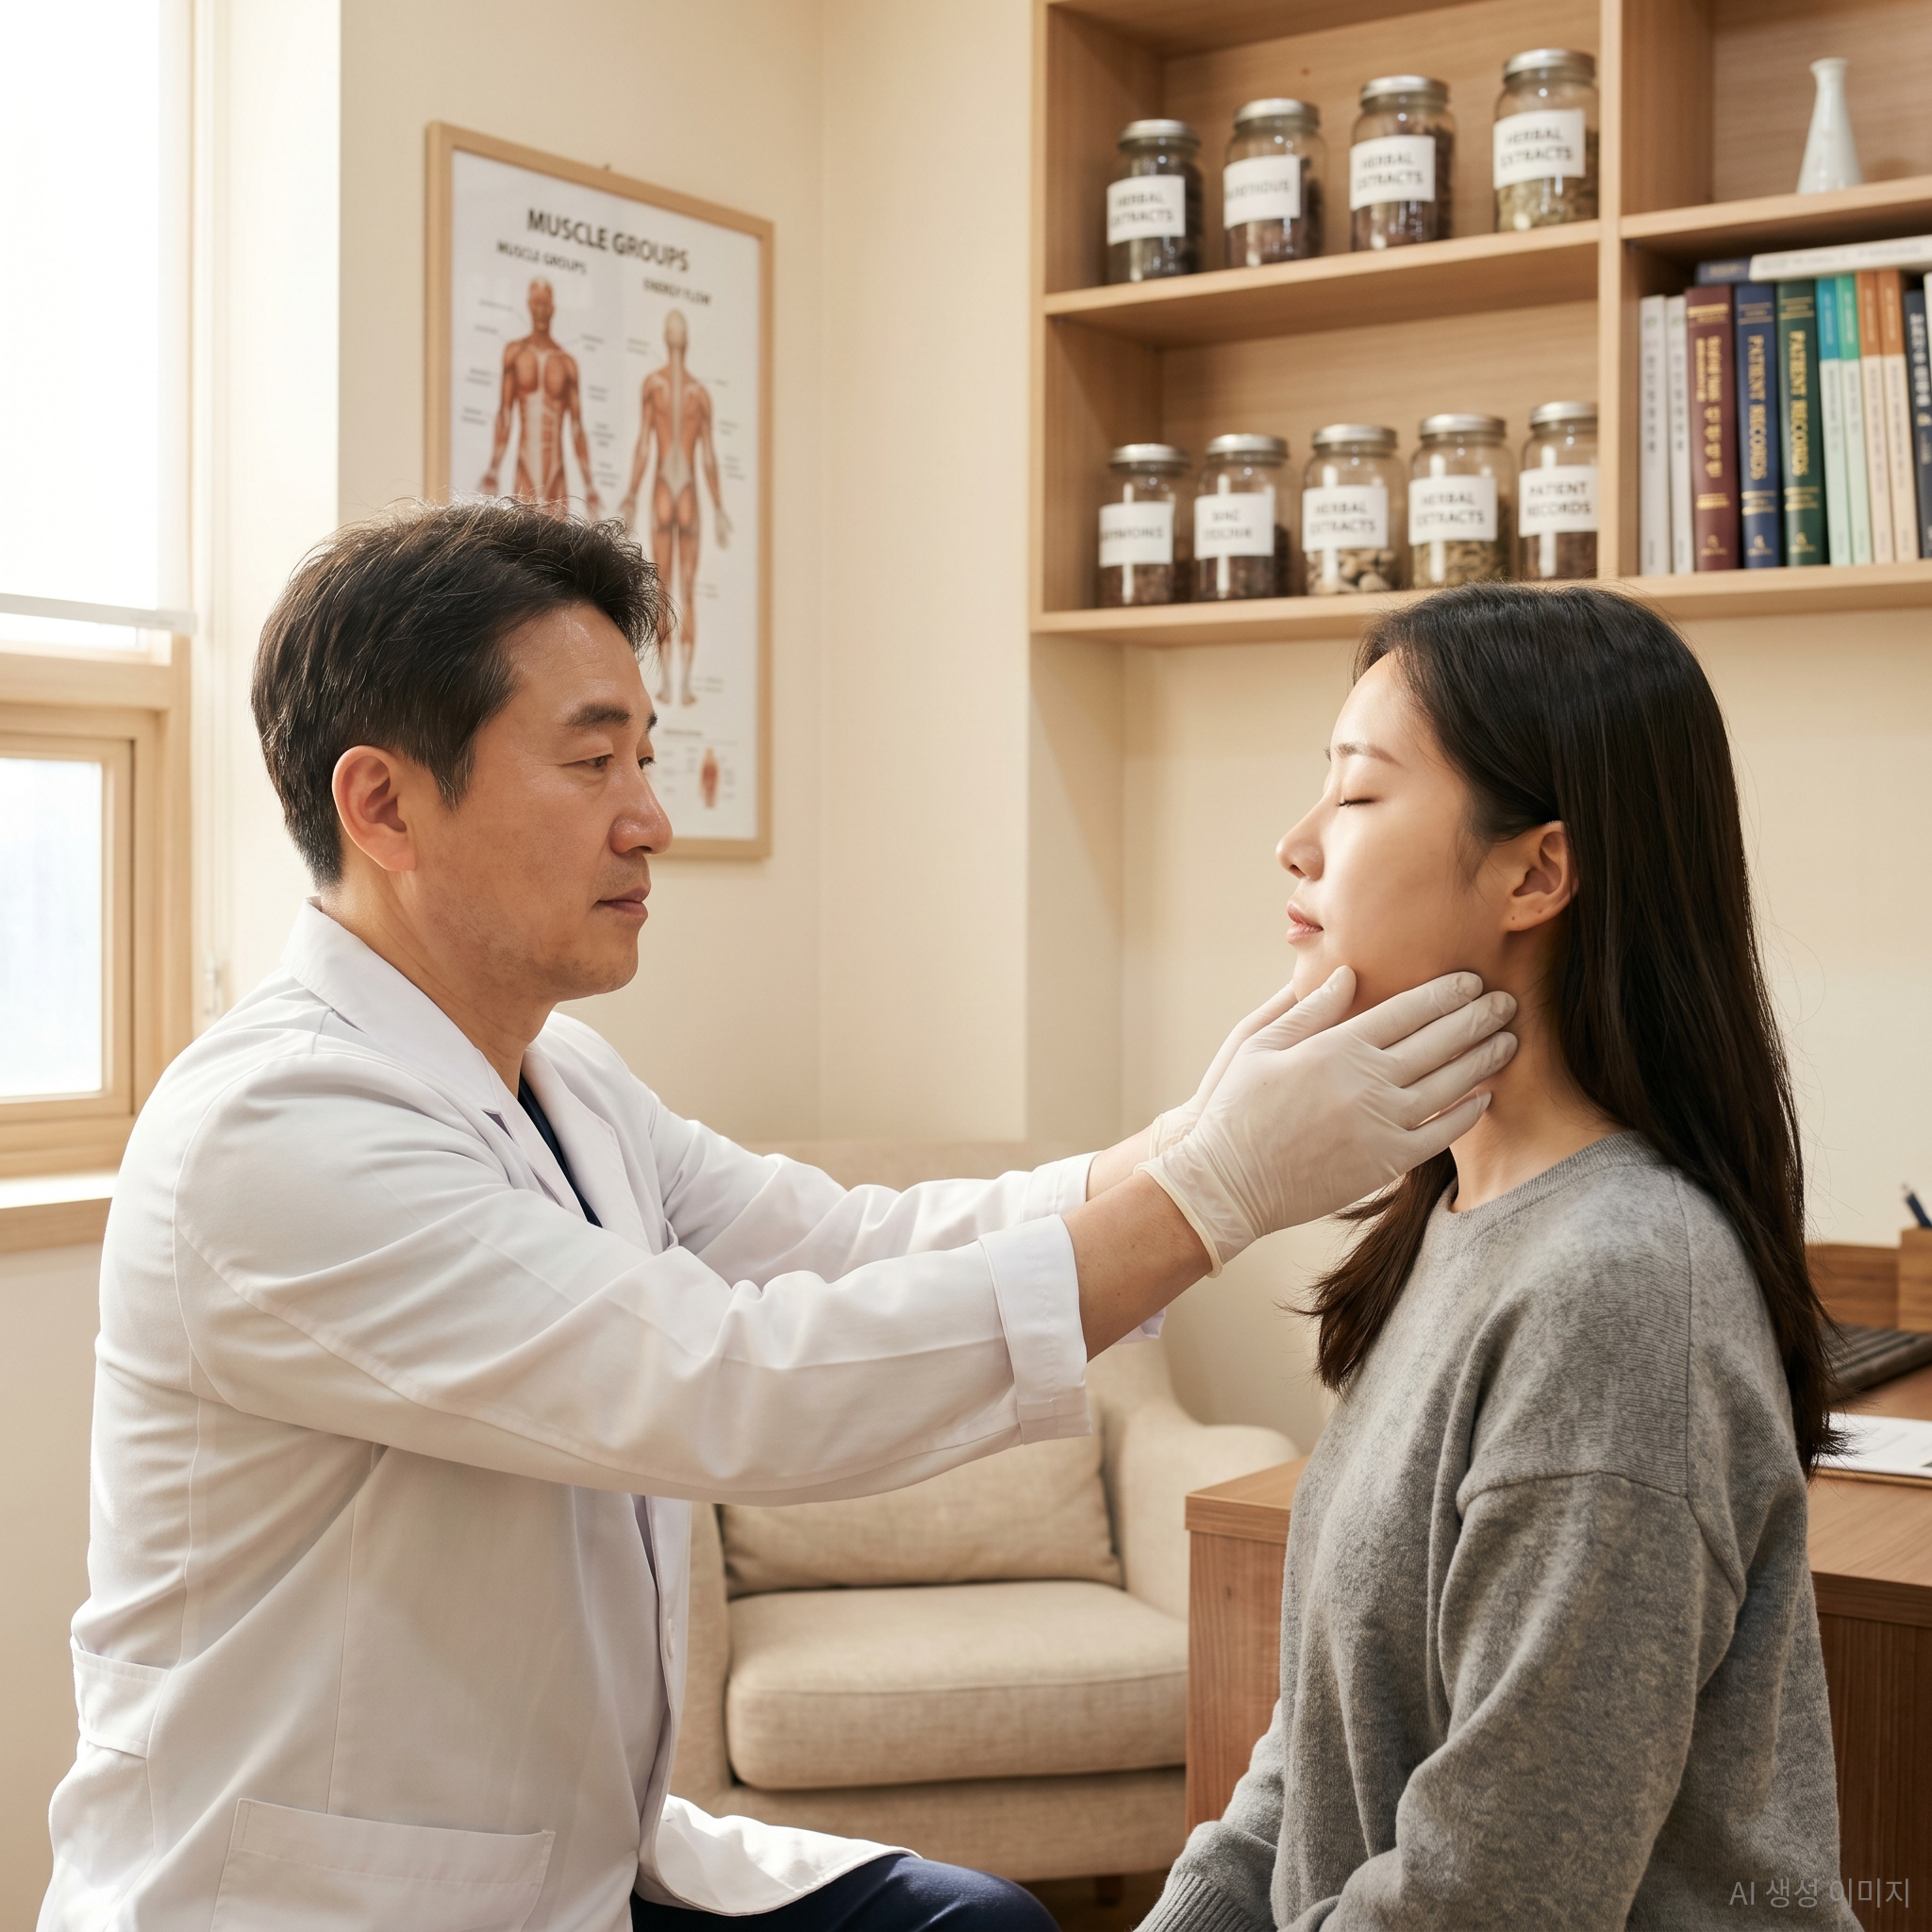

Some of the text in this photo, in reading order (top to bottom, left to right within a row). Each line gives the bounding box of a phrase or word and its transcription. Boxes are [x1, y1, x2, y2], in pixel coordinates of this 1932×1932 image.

[1505, 127, 1561, 145] HERBAL
[1361, 153, 1413, 169] HERBAL
[1499, 146, 1574, 169] EXTRACTS
[1356, 170, 1424, 191] EXTRACTS
[526, 208, 690, 273] MUSCLE GROUPS
[496, 241, 587, 275] MUSCLE GROUPS
[1747, 335, 1766, 401] PATIENT
[1789, 330, 1807, 397] PATIENT
[1749, 403, 1768, 480] RECORDS
[1790, 399, 1809, 477] RECORDS
[1421, 491, 1474, 507] HERBAL
[1529, 481, 1587, 497] PATIENT
[1315, 502, 1366, 515] HERBAL
[1416, 509, 1485, 528] EXTRACTS
[1527, 500, 1591, 518] RECORDS
[1308, 518, 1376, 536] EXTRACTS
